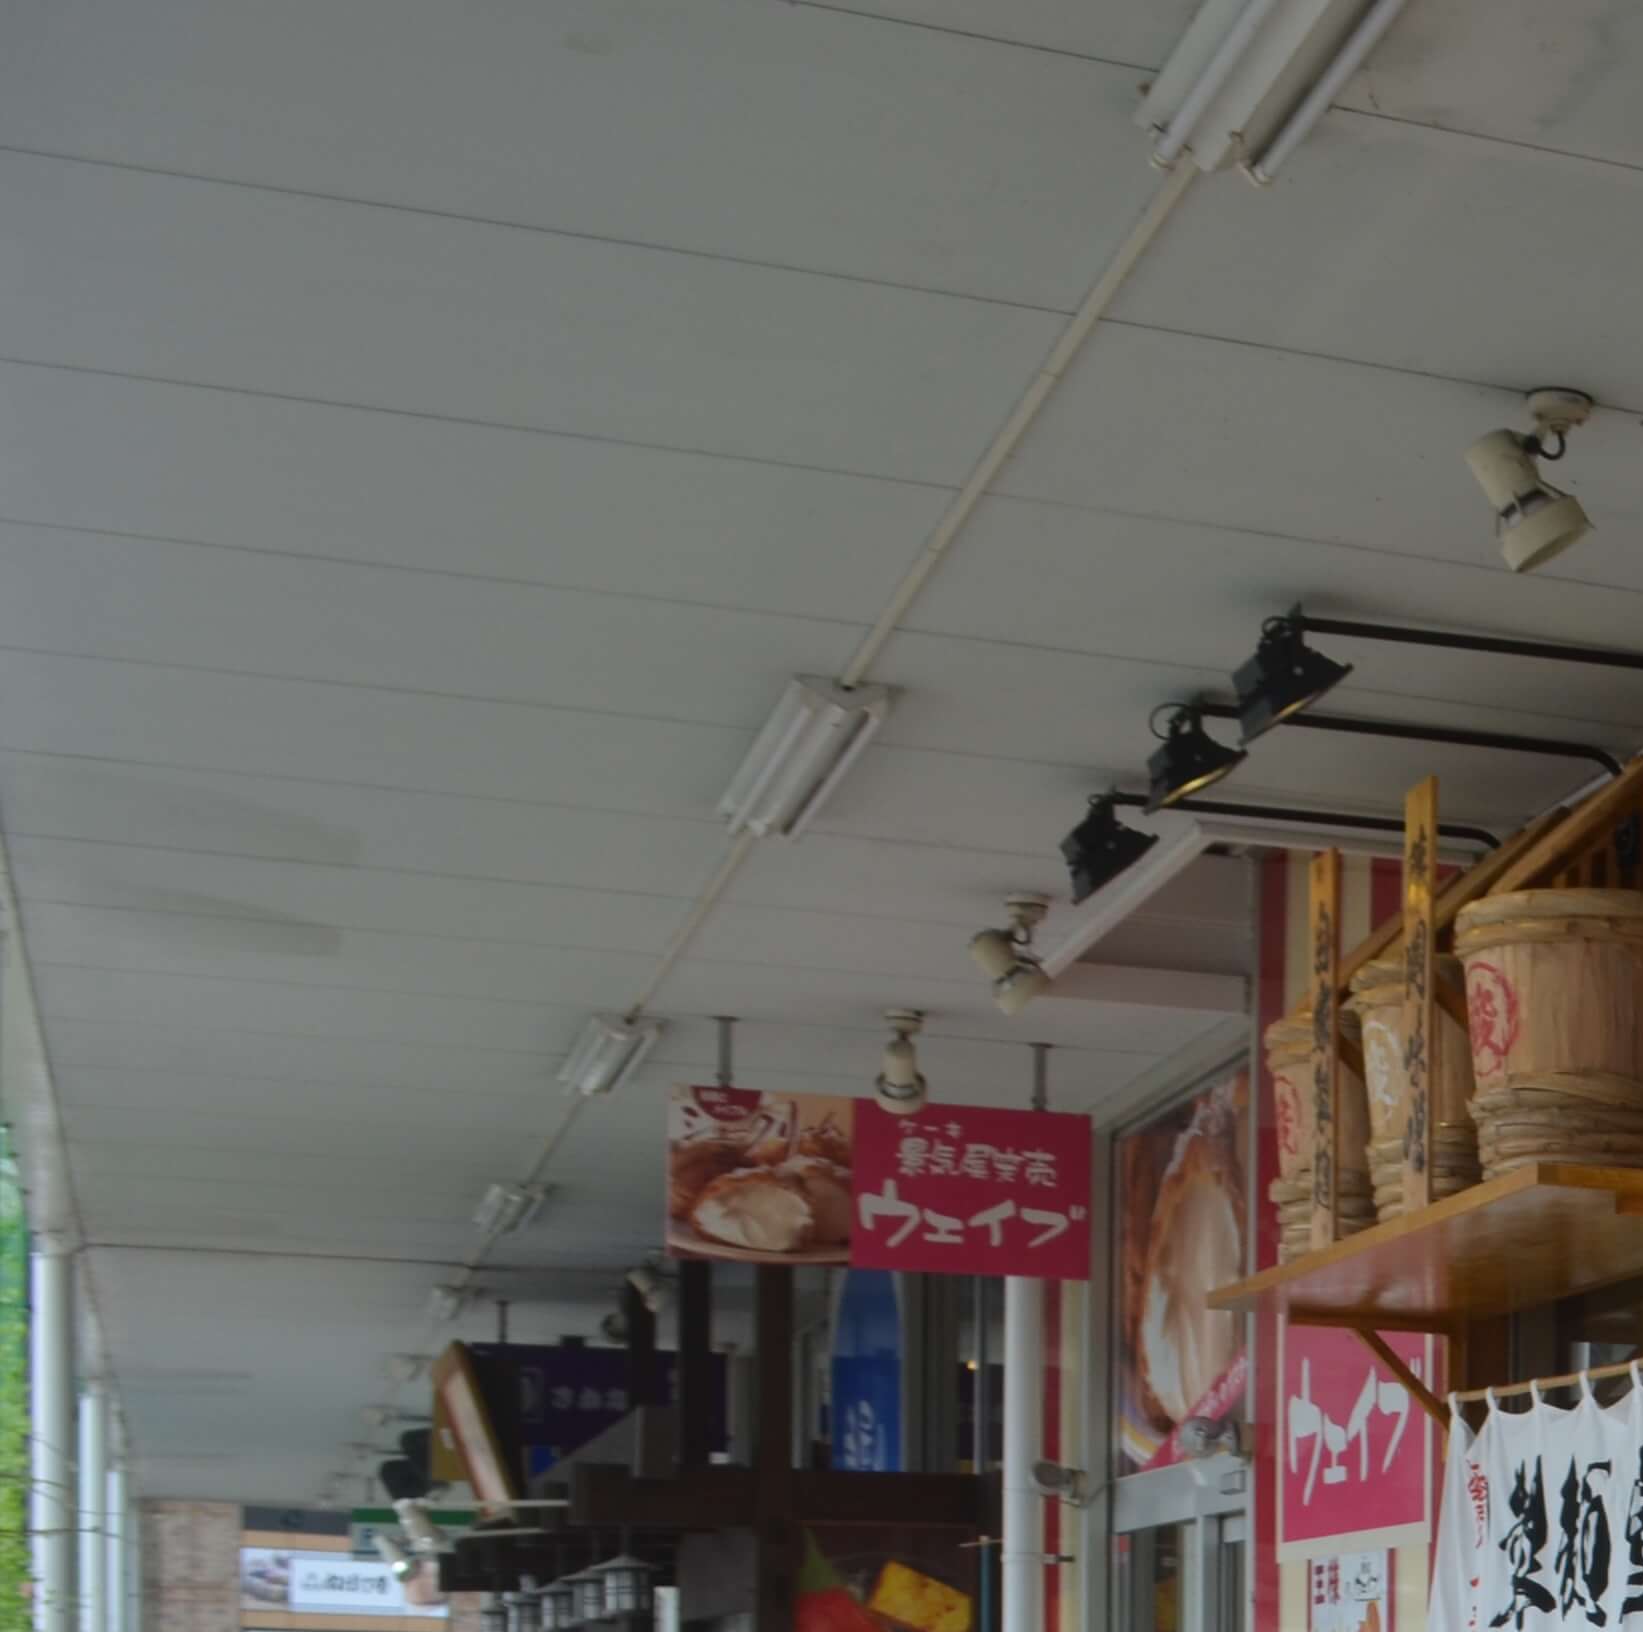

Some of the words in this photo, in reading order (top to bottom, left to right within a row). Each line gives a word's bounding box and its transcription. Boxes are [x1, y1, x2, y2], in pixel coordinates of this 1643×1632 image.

[858, 1179, 1086, 1248] ウェイブ
[1289, 1357, 1421, 1506] ウェイブ
